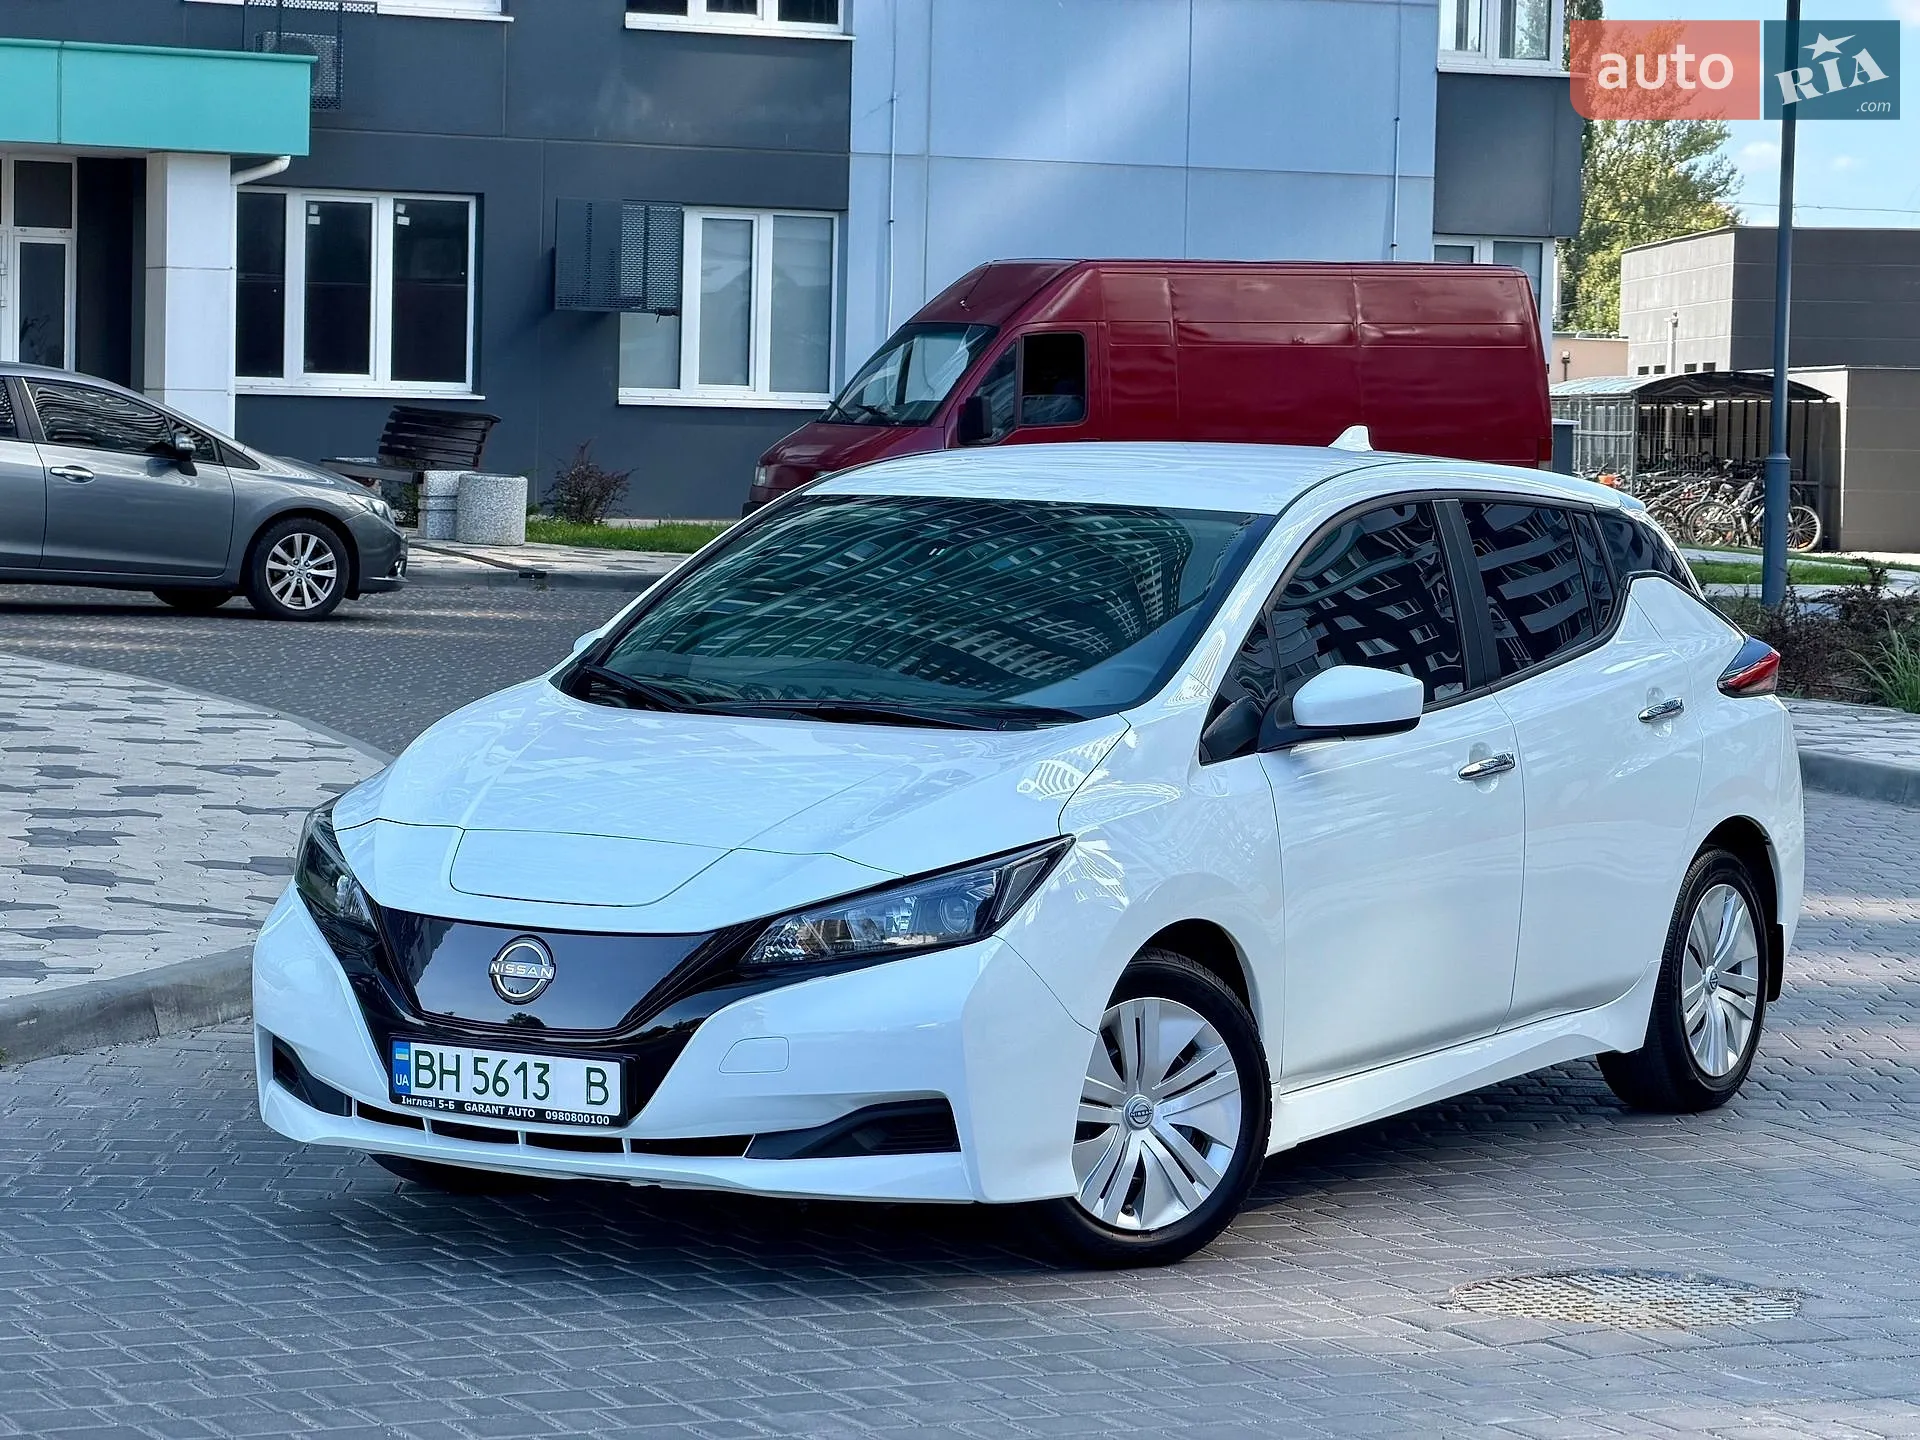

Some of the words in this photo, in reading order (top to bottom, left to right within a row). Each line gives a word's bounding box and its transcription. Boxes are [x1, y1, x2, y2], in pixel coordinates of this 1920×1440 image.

[490, 962, 553, 978] NISSAN
[395, 1073, 410, 1087] UA
[414, 1049, 461, 1093] BH
[472, 1056, 550, 1100] 5613
[585, 1066, 610, 1105] B
[464, 1102, 505, 1115] GARANT
[508, 1107, 536, 1118] AUTO
[545, 1110, 610, 1125] 0980800100
